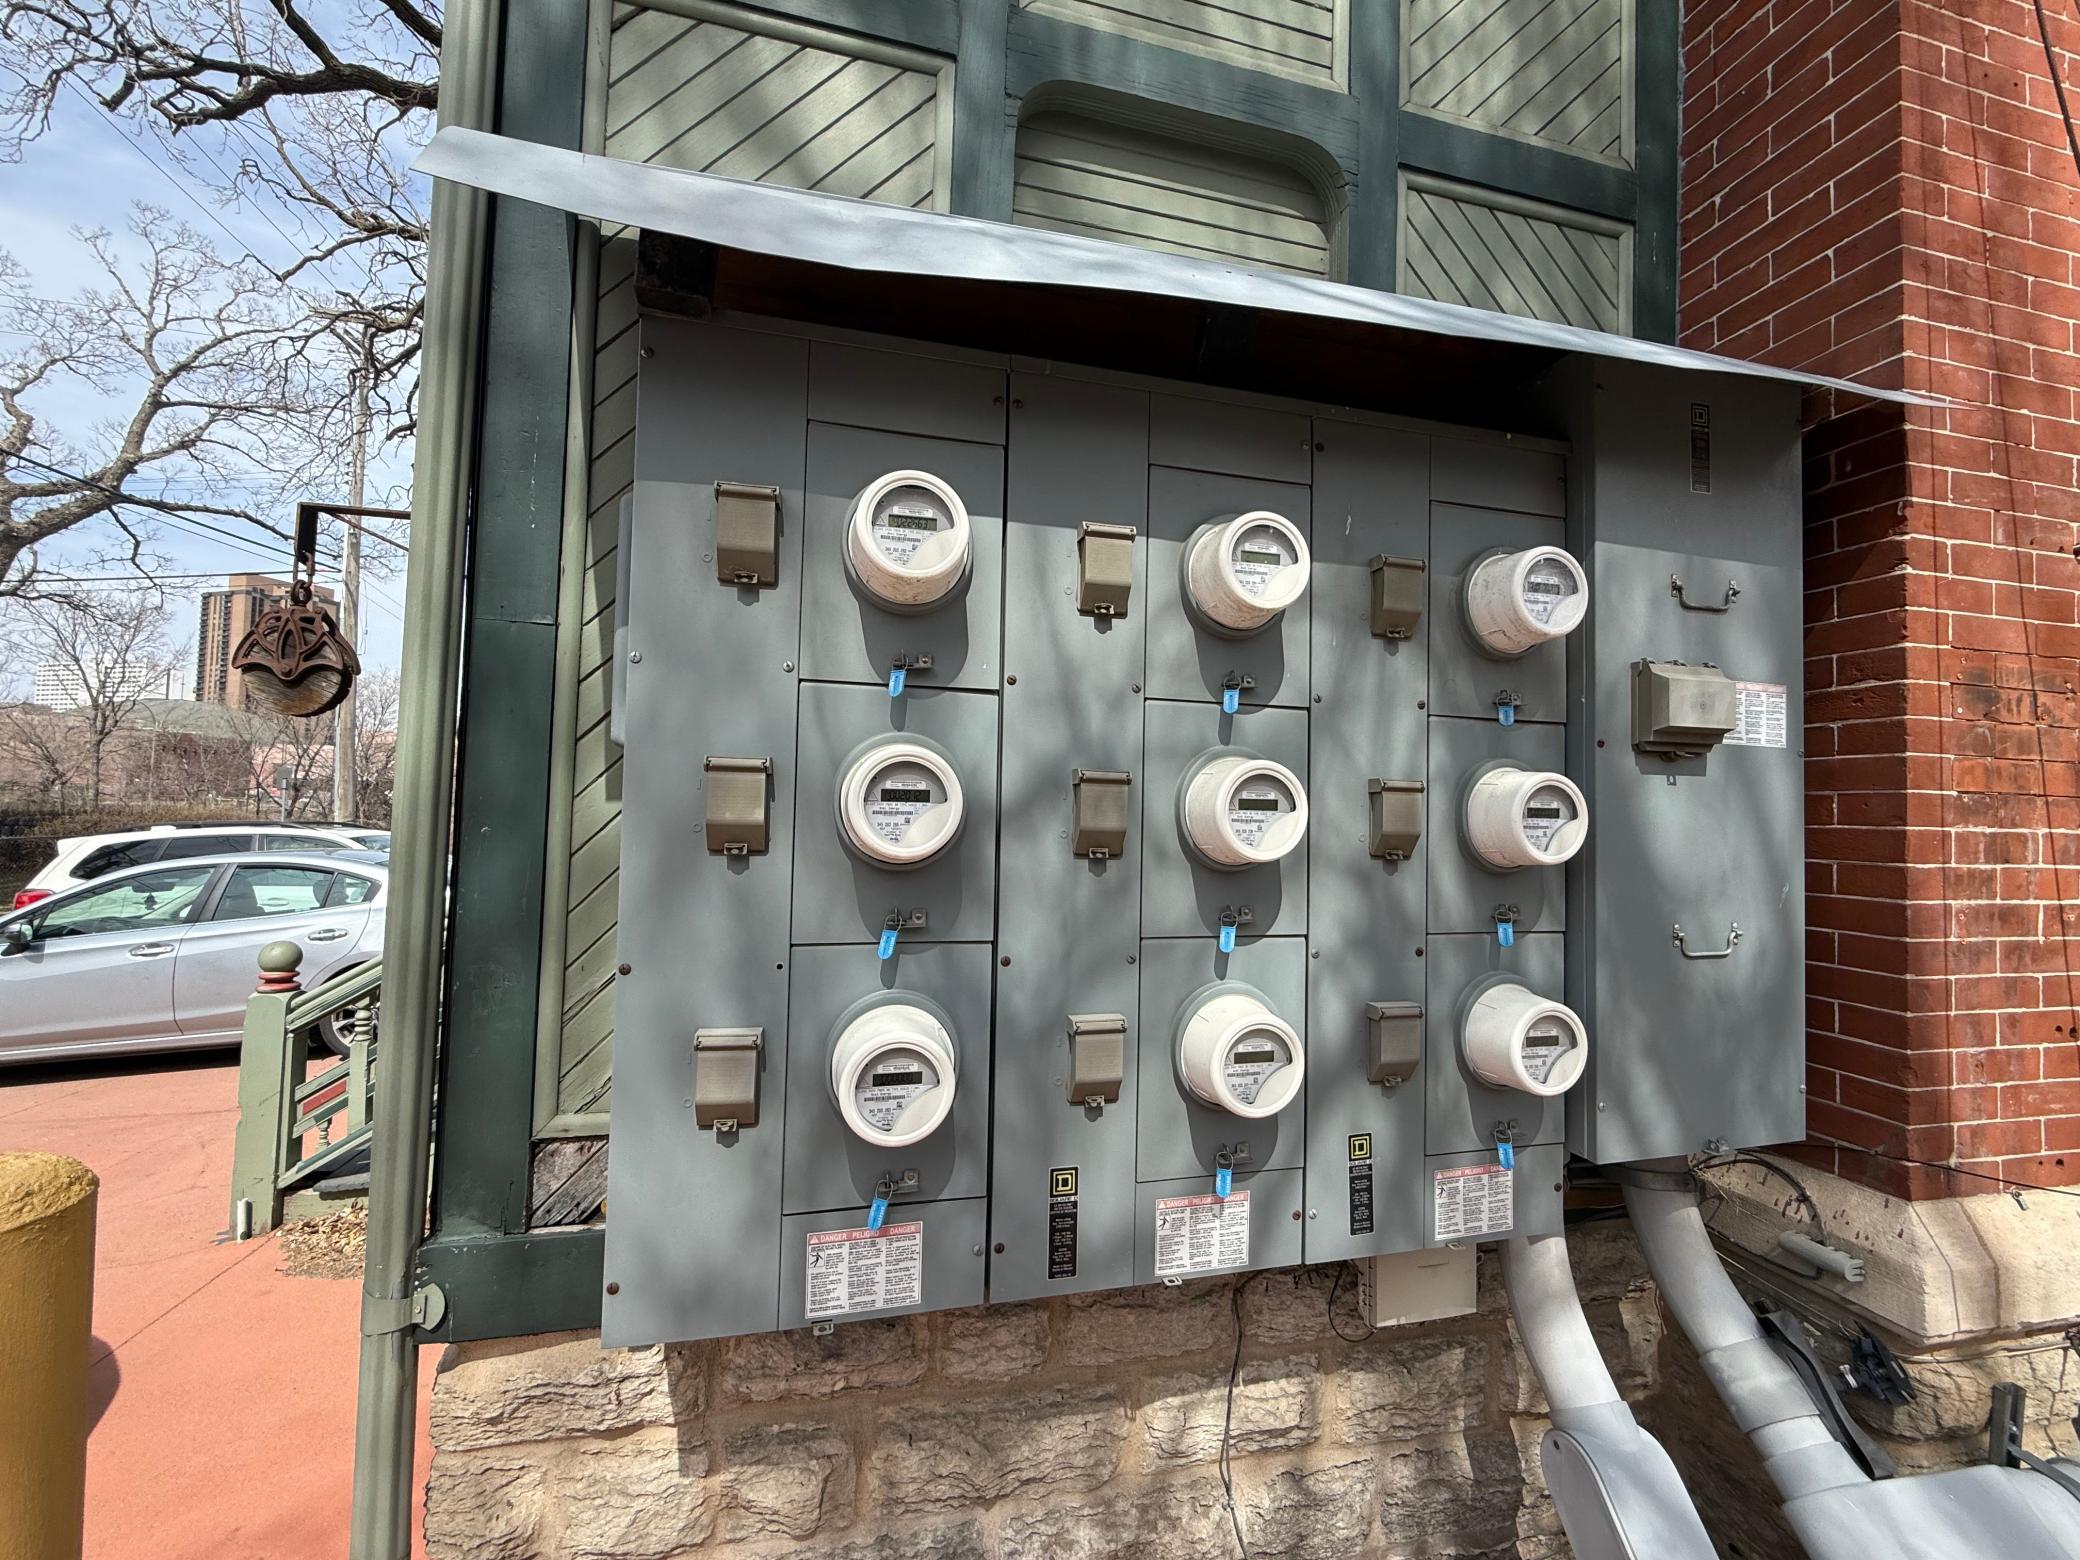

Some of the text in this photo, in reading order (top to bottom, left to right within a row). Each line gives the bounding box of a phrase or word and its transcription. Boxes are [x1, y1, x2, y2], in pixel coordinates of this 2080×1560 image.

[1056, 1174, 1071, 1191] D
[820, 1233, 847, 1243] DANGER
[890, 1225, 917, 1235] DANGER
